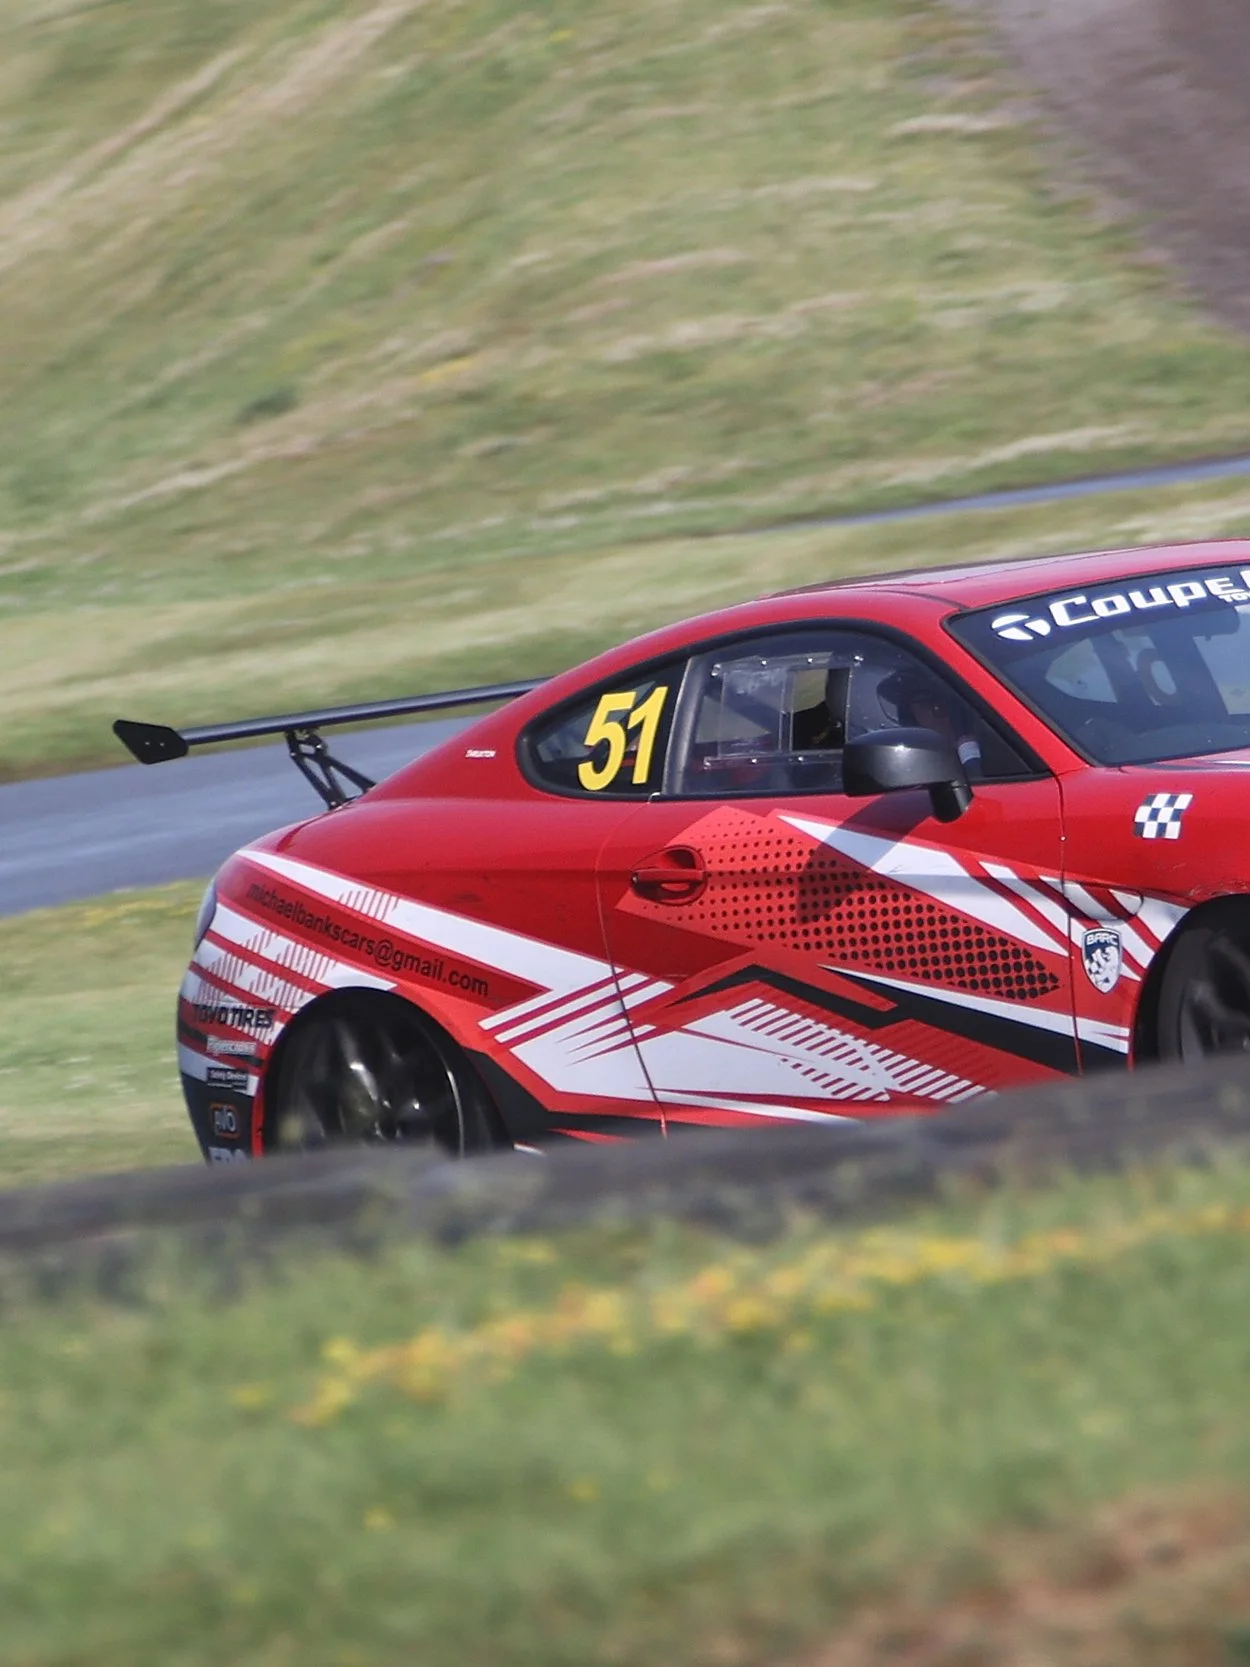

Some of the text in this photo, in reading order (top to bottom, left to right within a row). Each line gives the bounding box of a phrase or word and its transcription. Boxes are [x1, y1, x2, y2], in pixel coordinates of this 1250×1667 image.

[577, 686, 668, 791] 51
[246, 882, 489, 997] michaelbankscars@gmail.com
[1086, 931, 1118, 946] BARC
